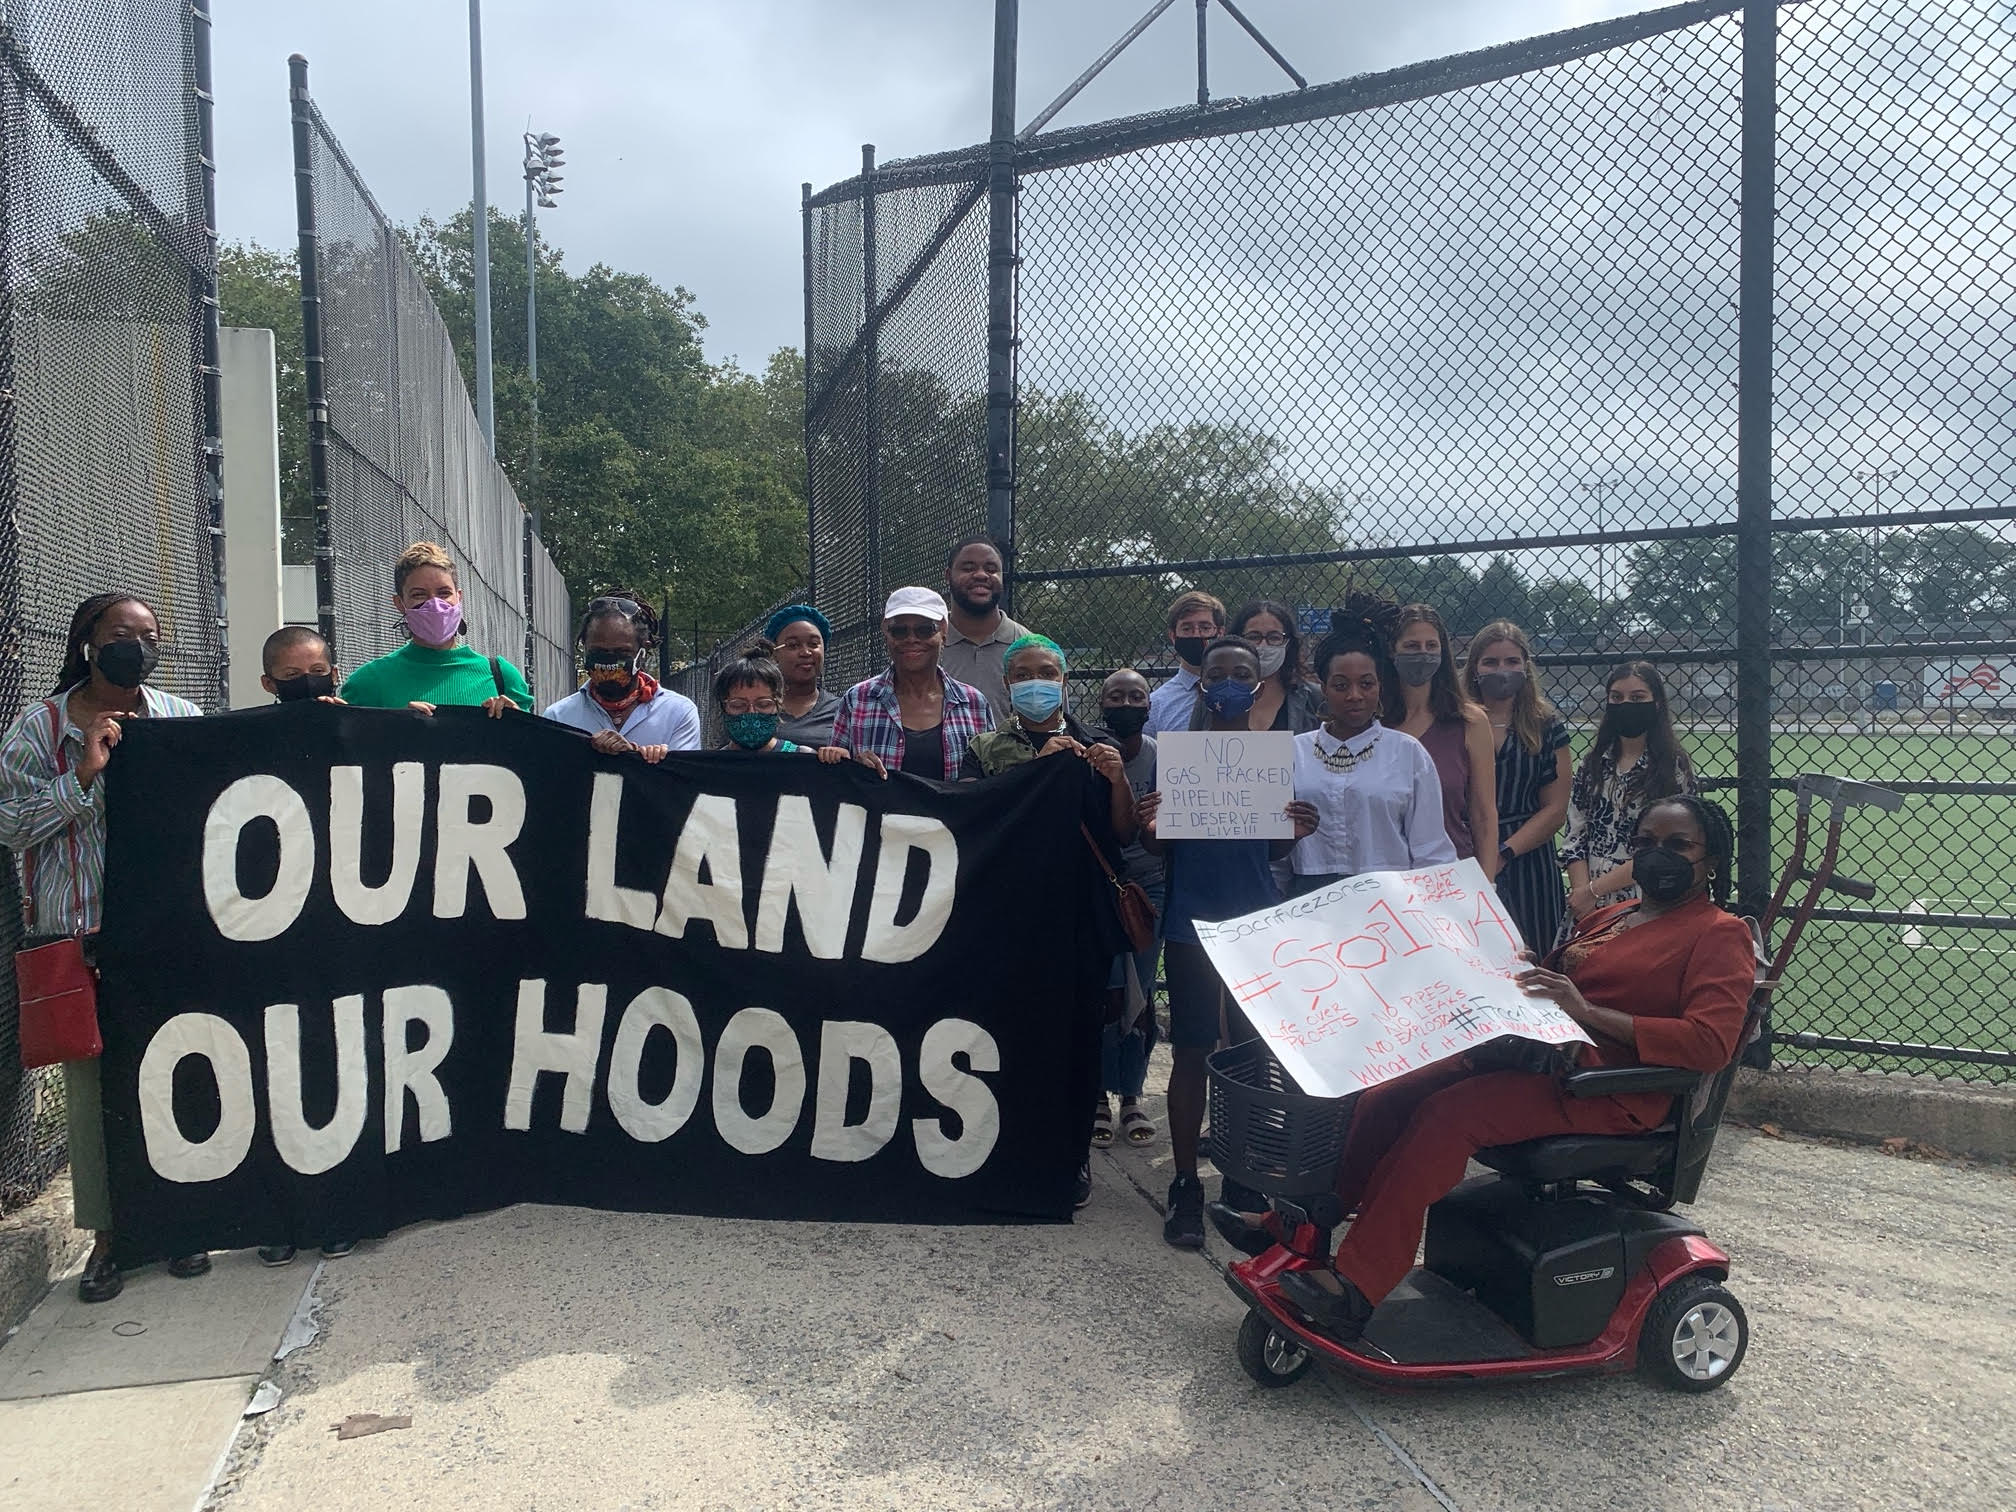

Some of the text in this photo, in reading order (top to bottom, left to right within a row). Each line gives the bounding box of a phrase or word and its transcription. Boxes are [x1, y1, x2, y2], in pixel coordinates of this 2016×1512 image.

[1204, 737, 1245, 768] NO
[1166, 767, 1291, 786] GAS FRACKED
[1172, 789, 1253, 807] PIPELINE
[1164, 812, 1289, 828] I DESERVE TO
[1207, 825, 1256, 837] LIVE!!!
[202, 762, 959, 963] OUR LAND
[1416, 988, 1467, 1020] LEAKS
[138, 977, 1001, 1183] OUR HOODS
[1559, 1271, 1601, 1284] VICTORY
